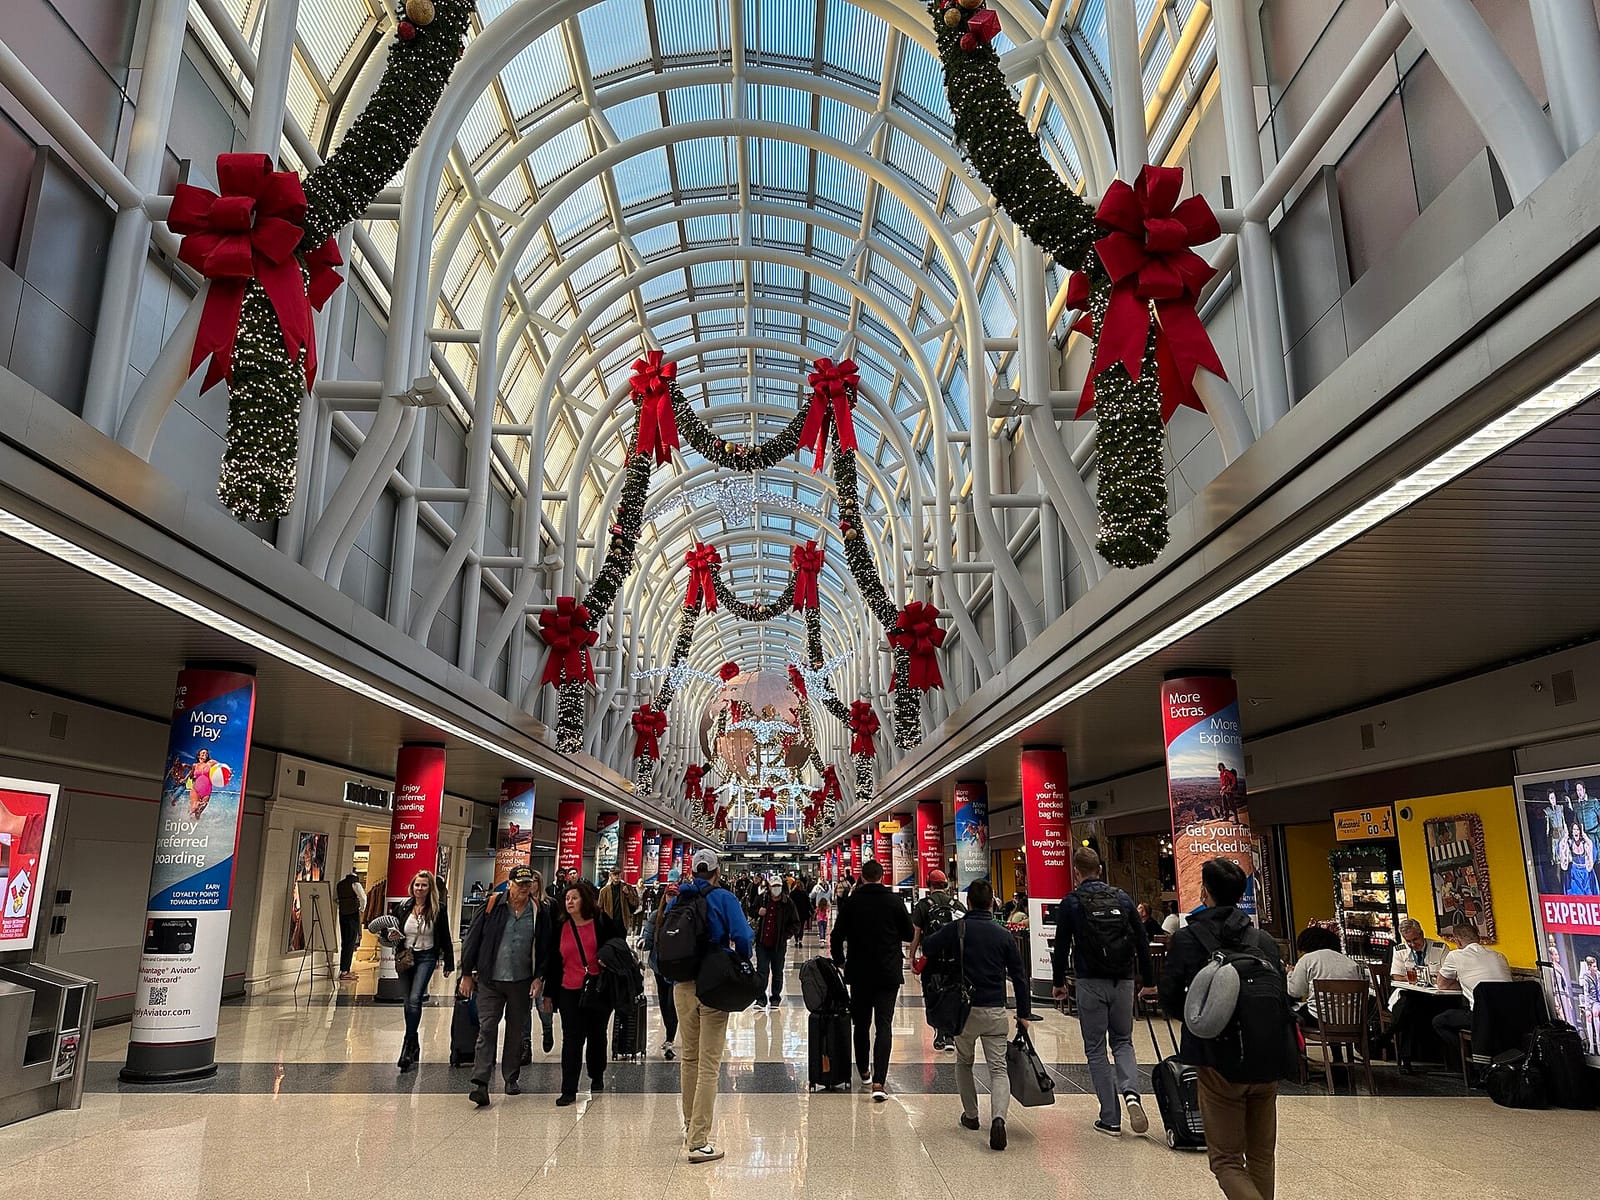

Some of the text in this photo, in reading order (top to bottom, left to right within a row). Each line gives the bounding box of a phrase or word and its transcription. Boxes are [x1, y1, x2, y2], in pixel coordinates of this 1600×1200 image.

[1169, 692, 1201, 705] More
[190, 711, 228, 724] More
[1170, 706, 1207, 719] Extras.
[1210, 717, 1238, 730] More
[192, 725, 221, 741] Play.
[402, 784, 421, 794] Enjoy
[397, 794, 426, 802] preferred
[396, 803, 425, 812] boarding
[1038, 801, 1064, 809] checked
[1038, 811, 1051, 819] bag
[1360, 812, 1371, 822] TO
[165, 819, 198, 835] Enjoy
[400, 822, 415, 830] Earn
[1367, 824, 1379, 835] GO
[408, 832, 430, 840] Points
[1186, 825, 1208, 837] Get
[1209, 826, 1237, 840] your
[156, 835, 208, 848] preferred
[395, 842, 418, 850] toward
[1032, 840, 1055, 848] Loyalty
[1189, 839, 1238, 853] checked
[154, 852, 206, 868] boarding
[1544, 901, 1600, 926] EXPERIE
